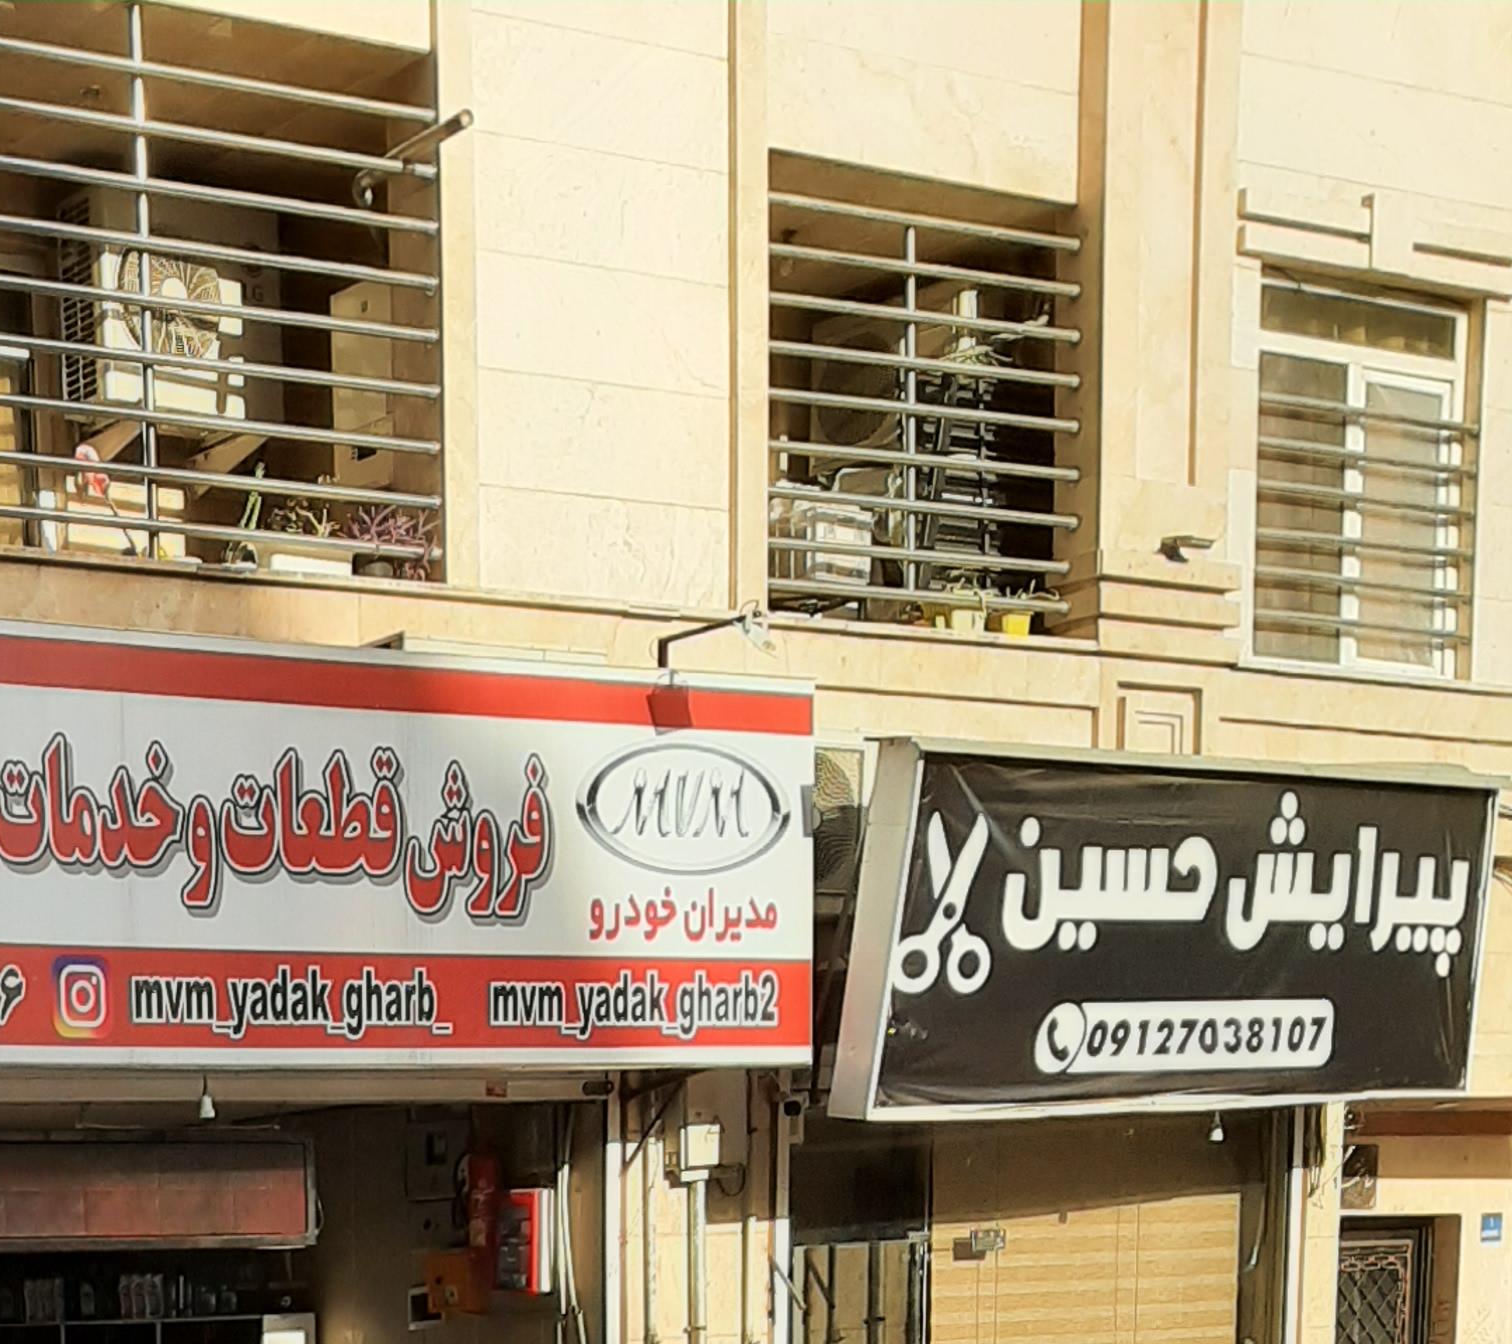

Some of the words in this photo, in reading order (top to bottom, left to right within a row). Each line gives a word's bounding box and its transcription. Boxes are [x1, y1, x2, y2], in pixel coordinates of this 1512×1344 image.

[180, 794, 223, 909] و
[221, 746, 403, 874] قطعات
[404, 753, 552, 920] فروش
[588, 886, 678, 942] خودرو
[683, 887, 779, 942] مدیران
[1001, 817, 1218, 952] حسین
[1226, 791, 1470, 978] پیرایش
[129, 965, 452, 1039] mvm_yadak_gharb_
[489, 969, 779, 1039] mvm_yadak_gharb2
[1086, 1015, 1329, 1059] 09127038107
